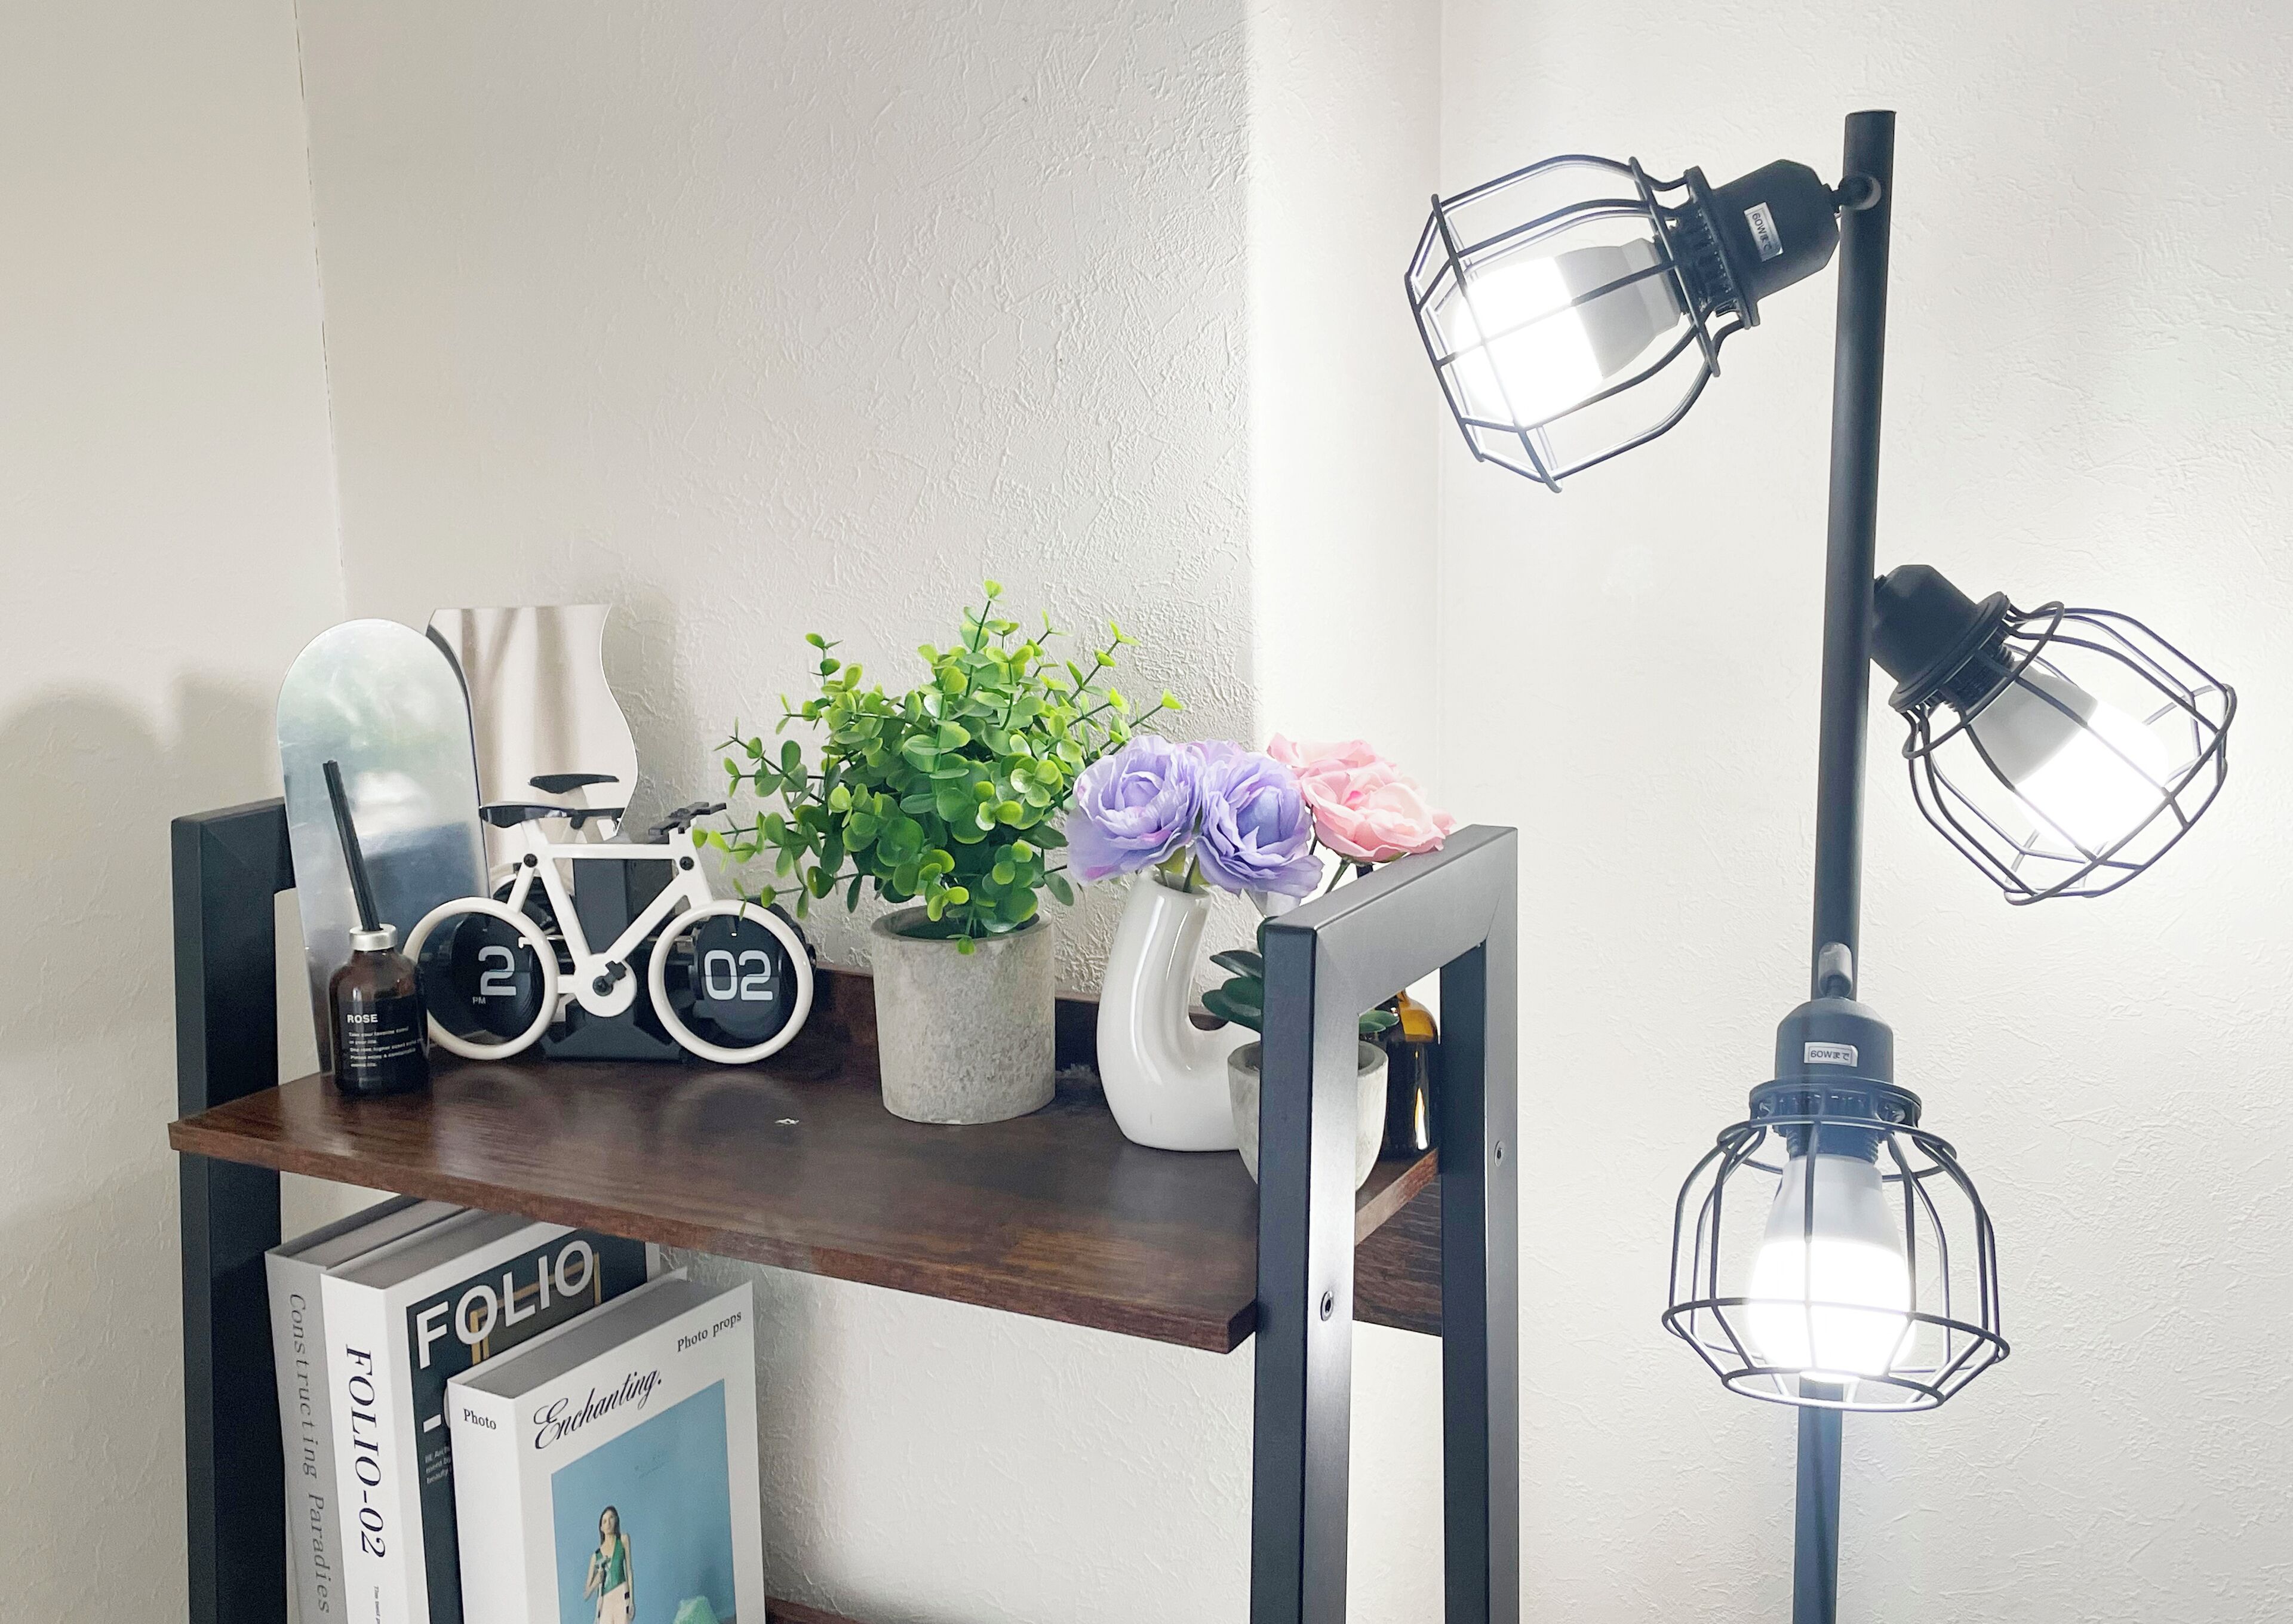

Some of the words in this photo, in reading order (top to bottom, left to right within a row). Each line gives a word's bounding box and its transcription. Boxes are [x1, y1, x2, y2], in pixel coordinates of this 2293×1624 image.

[478, 946, 517, 996] 2
[704, 950, 773, 1000] 02
[347, 1014, 379, 1023] ROSE
[1810, 1050, 1851, 1061] 60Wまで
[416, 1240, 594, 1370] FOLIO
[677, 1328, 708, 1352] Photo
[713, 1311, 742, 1337] props
[463, 1407, 497, 1430] Photo
[533, 1370, 662, 1449] Enchanting.
[290, 1294, 318, 1479] Constructing
[308, 1493, 331, 1613] Paradies
[346, 1344, 386, 1558] FOLIO-02
